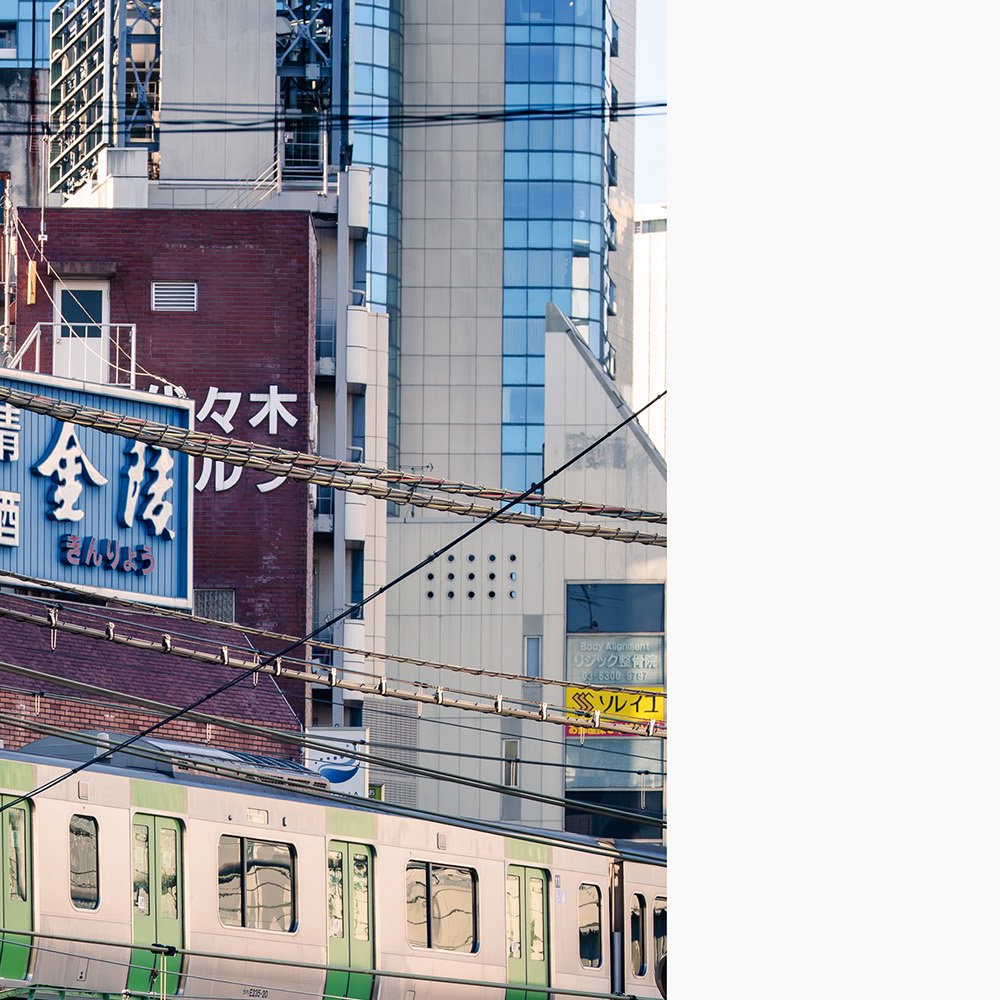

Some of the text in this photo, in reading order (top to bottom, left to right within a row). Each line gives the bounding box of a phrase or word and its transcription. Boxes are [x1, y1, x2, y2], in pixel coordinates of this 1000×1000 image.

[150, 384, 299, 435] 々木
[62, 533, 155, 576] きんりょう
